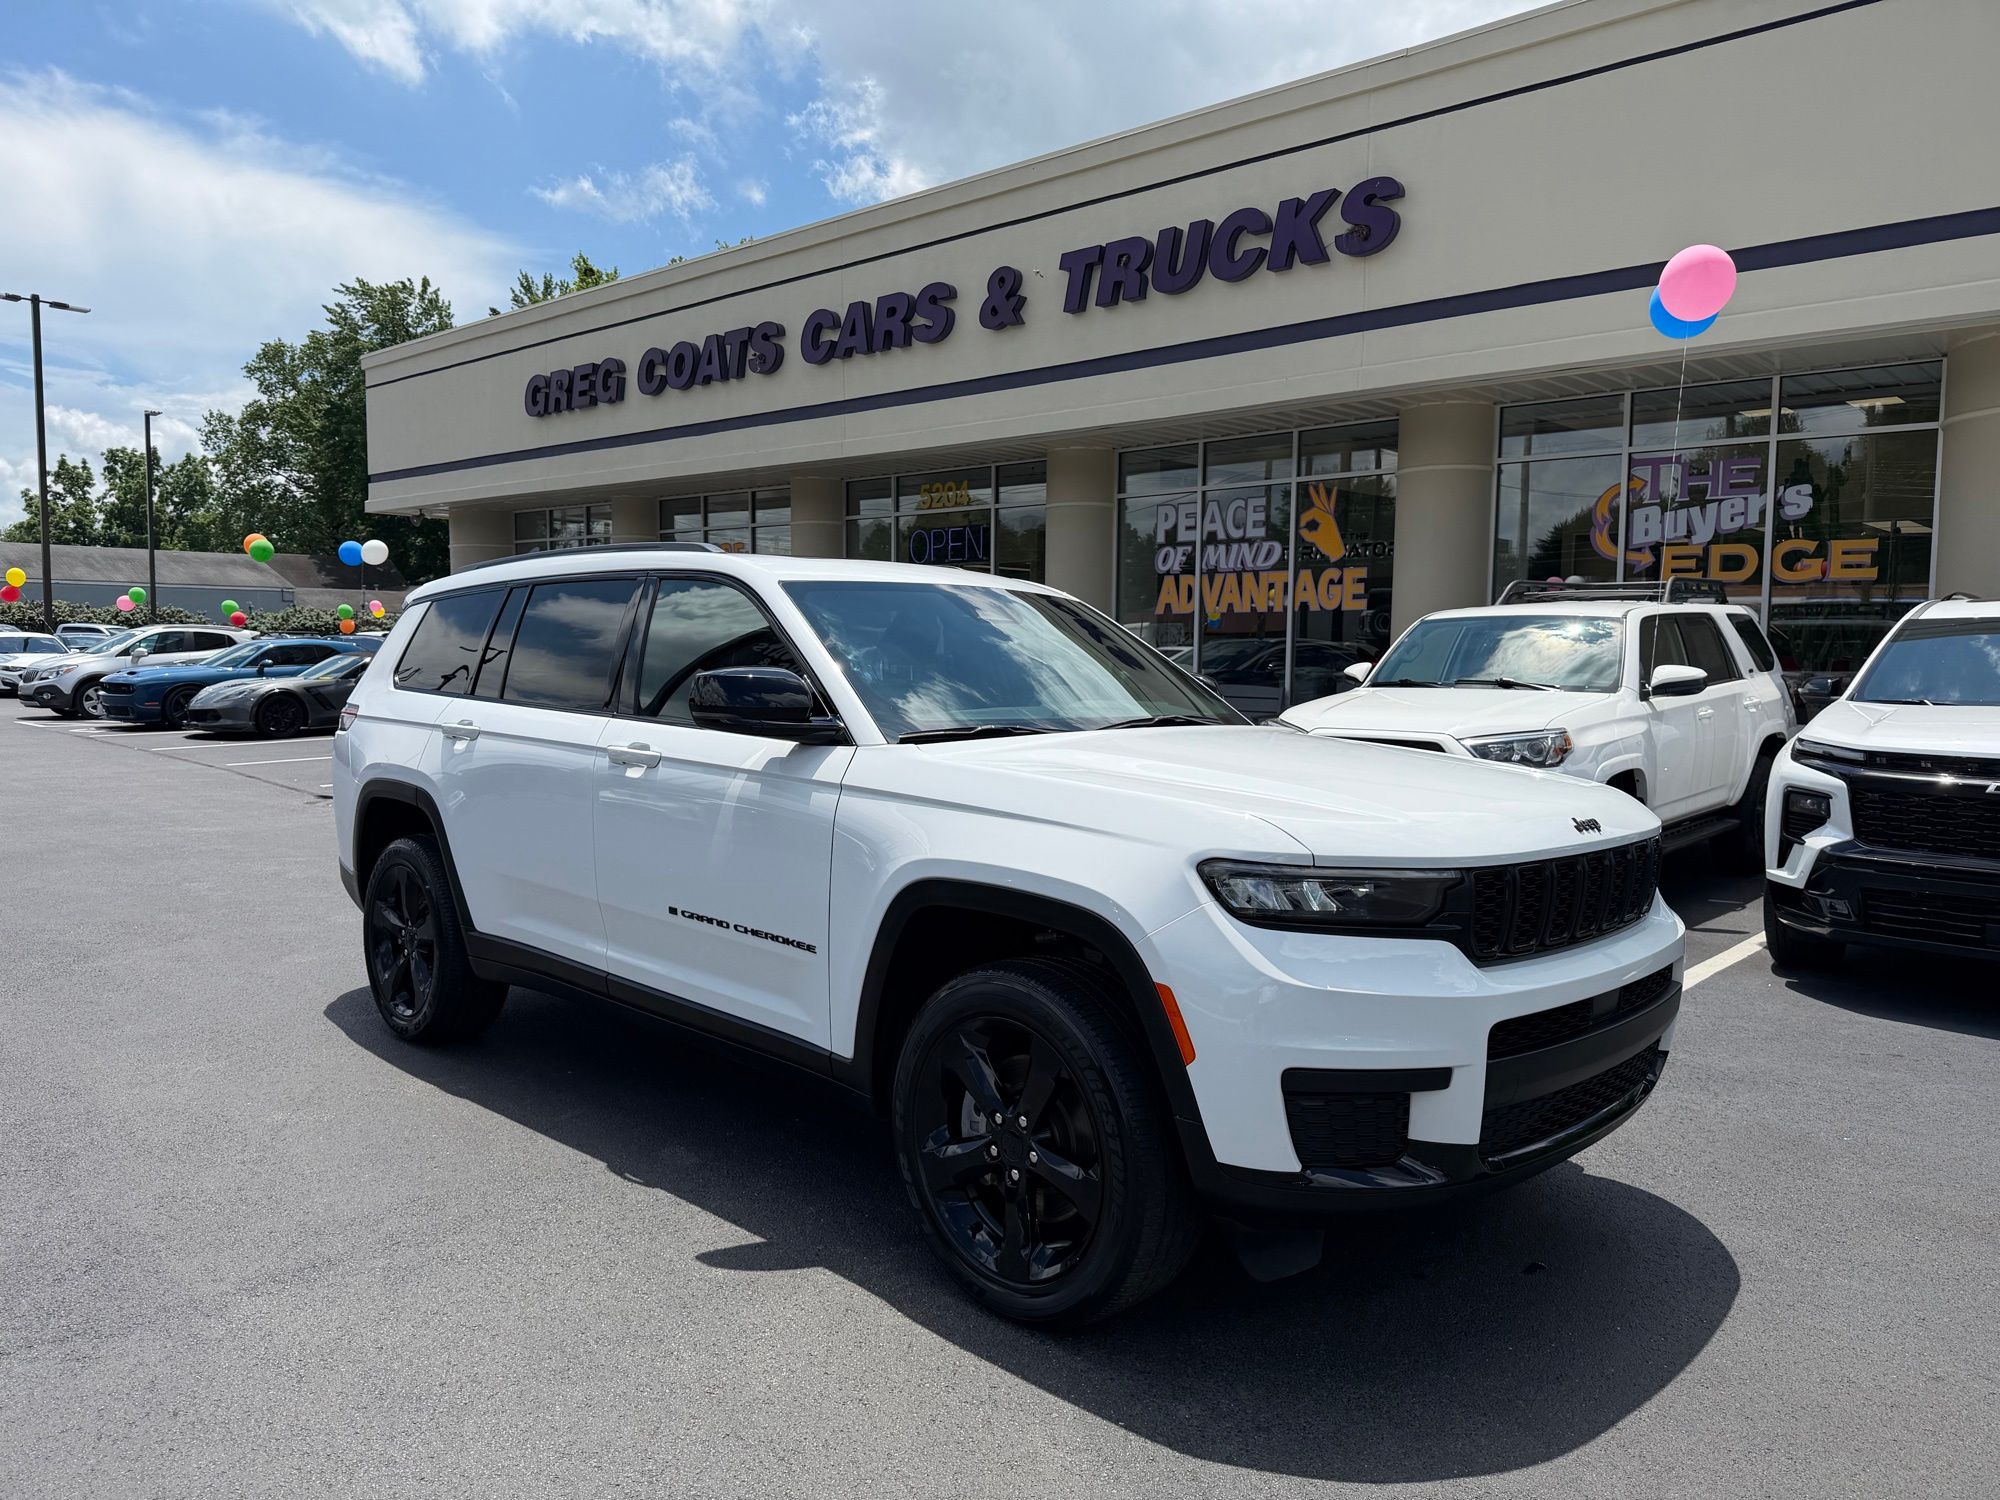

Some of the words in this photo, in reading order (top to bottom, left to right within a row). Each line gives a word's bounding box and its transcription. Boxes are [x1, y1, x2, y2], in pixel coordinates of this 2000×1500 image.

[525, 357, 627, 417] GREG
[638, 321, 786, 396] COATS
[801, 282, 957, 365] CARS
[979, 265, 1027, 330] &
[1059, 176, 1405, 314] TRUCKS
[919, 480, 971, 509] 5204
[1630, 454, 1762, 505] THE
[1155, 496, 1267, 545] PEACE
[1630, 483, 1813, 549] Buyer's
[910, 527, 984, 564] OPEN
[1155, 546, 1193, 575] OF
[1202, 541, 1283, 573] MIND
[1660, 537, 1880, 584] EDGE
[1154, 566, 1369, 615] ADVANTAGE
[1571, 817, 1602, 835] Jeep
[681, 910, 730, 929] GRAND
[733, 923, 817, 954] CHEROKEE
